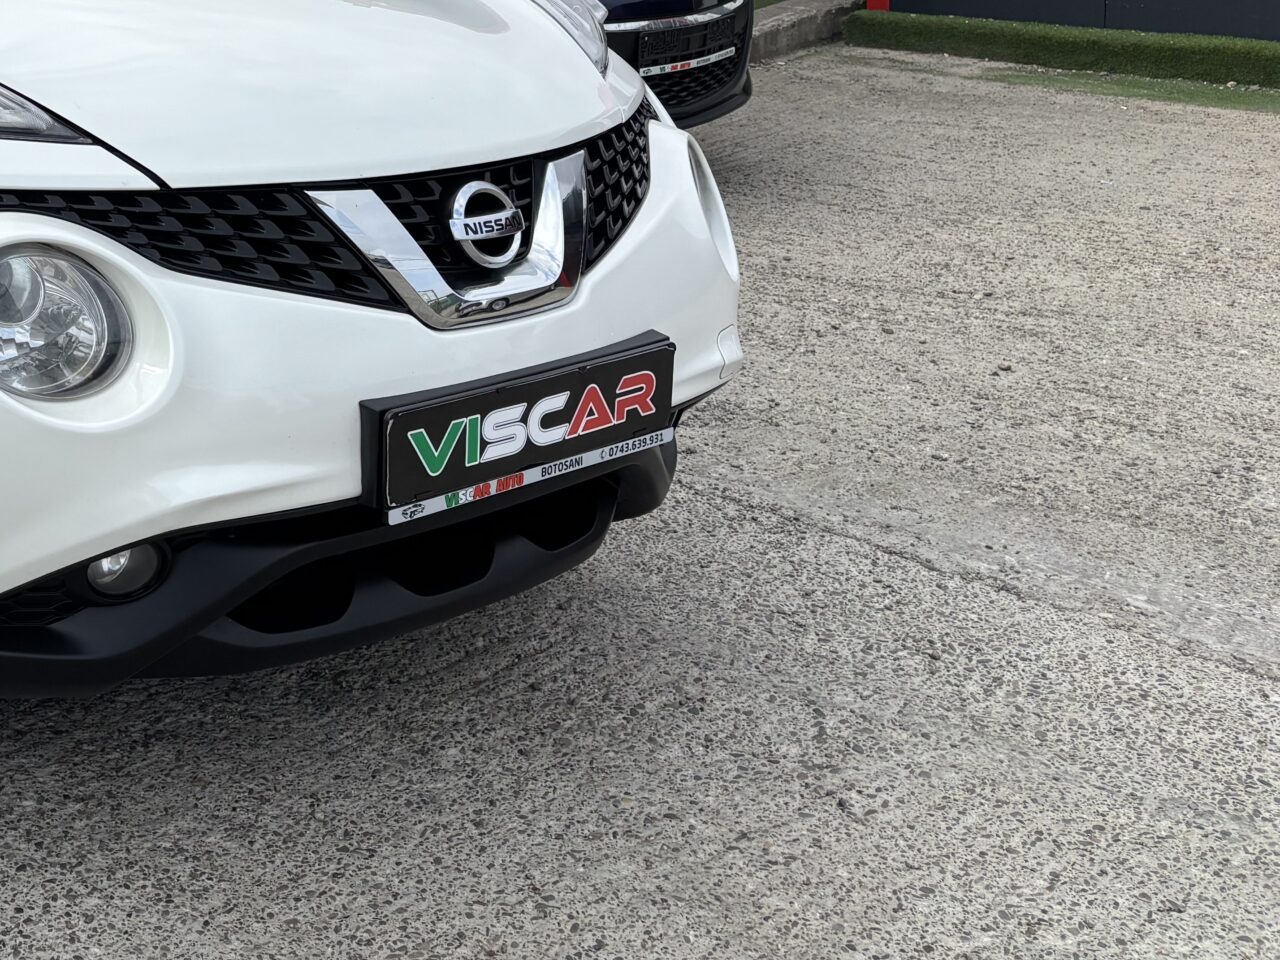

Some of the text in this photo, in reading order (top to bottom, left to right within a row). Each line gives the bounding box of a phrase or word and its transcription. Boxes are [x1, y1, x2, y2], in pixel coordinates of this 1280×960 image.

[463, 215, 523, 236] NISSAN
[407, 370, 657, 478] VISCAR
[445, 432, 664, 509] VISCAR AUTO BOTOSANI 0743.639.931
